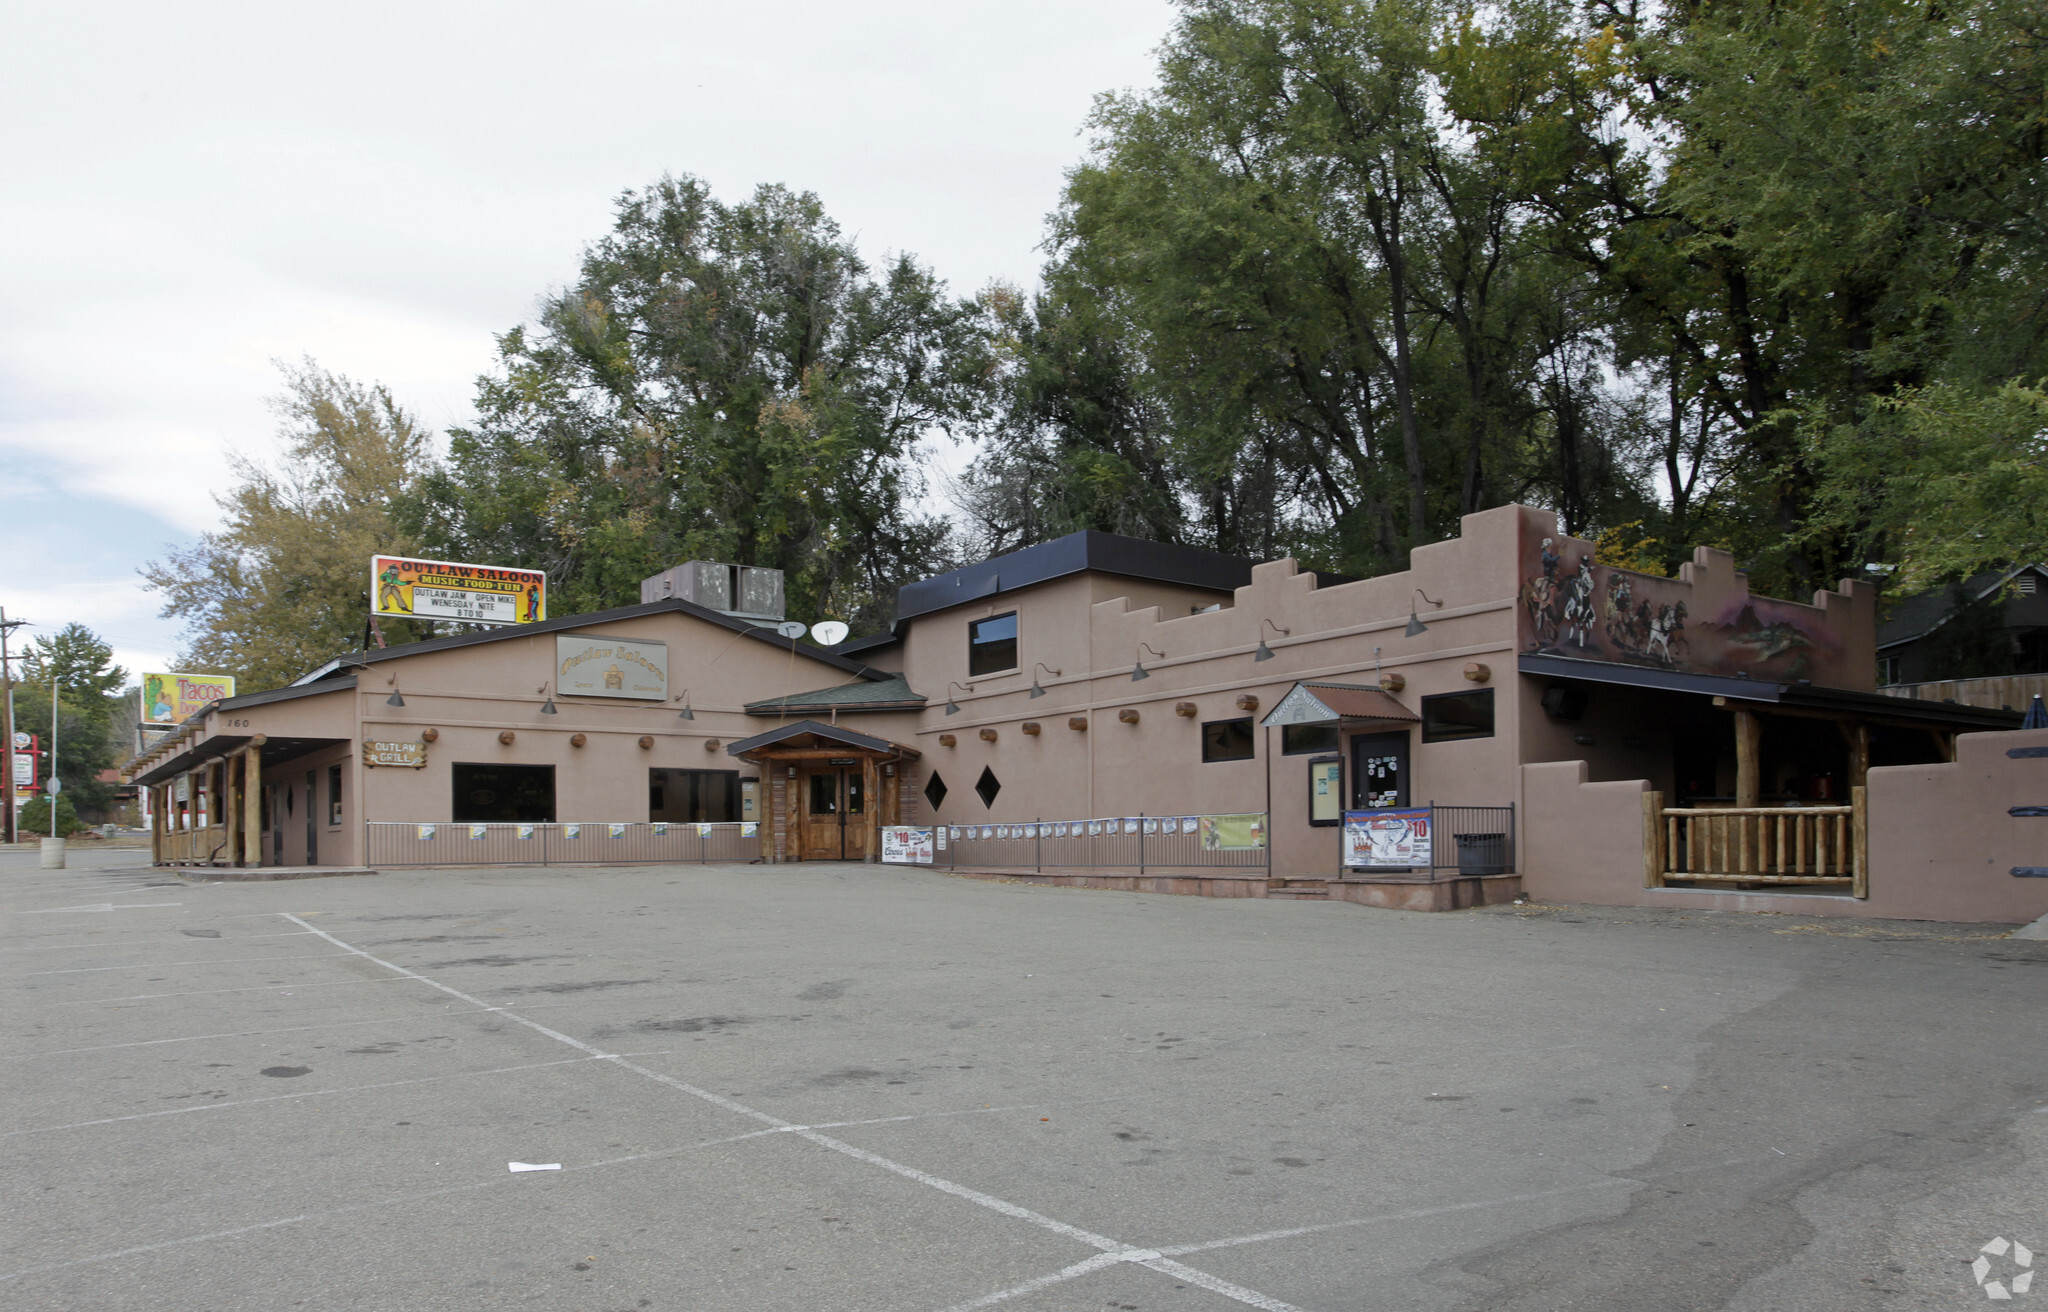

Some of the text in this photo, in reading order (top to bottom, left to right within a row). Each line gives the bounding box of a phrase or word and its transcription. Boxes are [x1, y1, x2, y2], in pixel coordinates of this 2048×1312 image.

[401, 561, 544, 584] OUTLAW SALOON
[421, 575, 522, 592] MUSIC FOOD FUN
[414, 588, 516, 604] OUTLAW JAM OPEN MIKE
[431, 598, 496, 611] WENESDAY NITE
[456, 608, 484, 618] 8 TO 10
[560, 646, 665, 682] Outlaw Saloon
[177, 678, 225, 700] Tacos
[227, 719, 249, 728] 160
[375, 742, 416, 752] OUTLAW
[380, 752, 411, 762] GRILL
[1407, 819, 1427, 837] $10
[894, 831, 909, 843] $10
